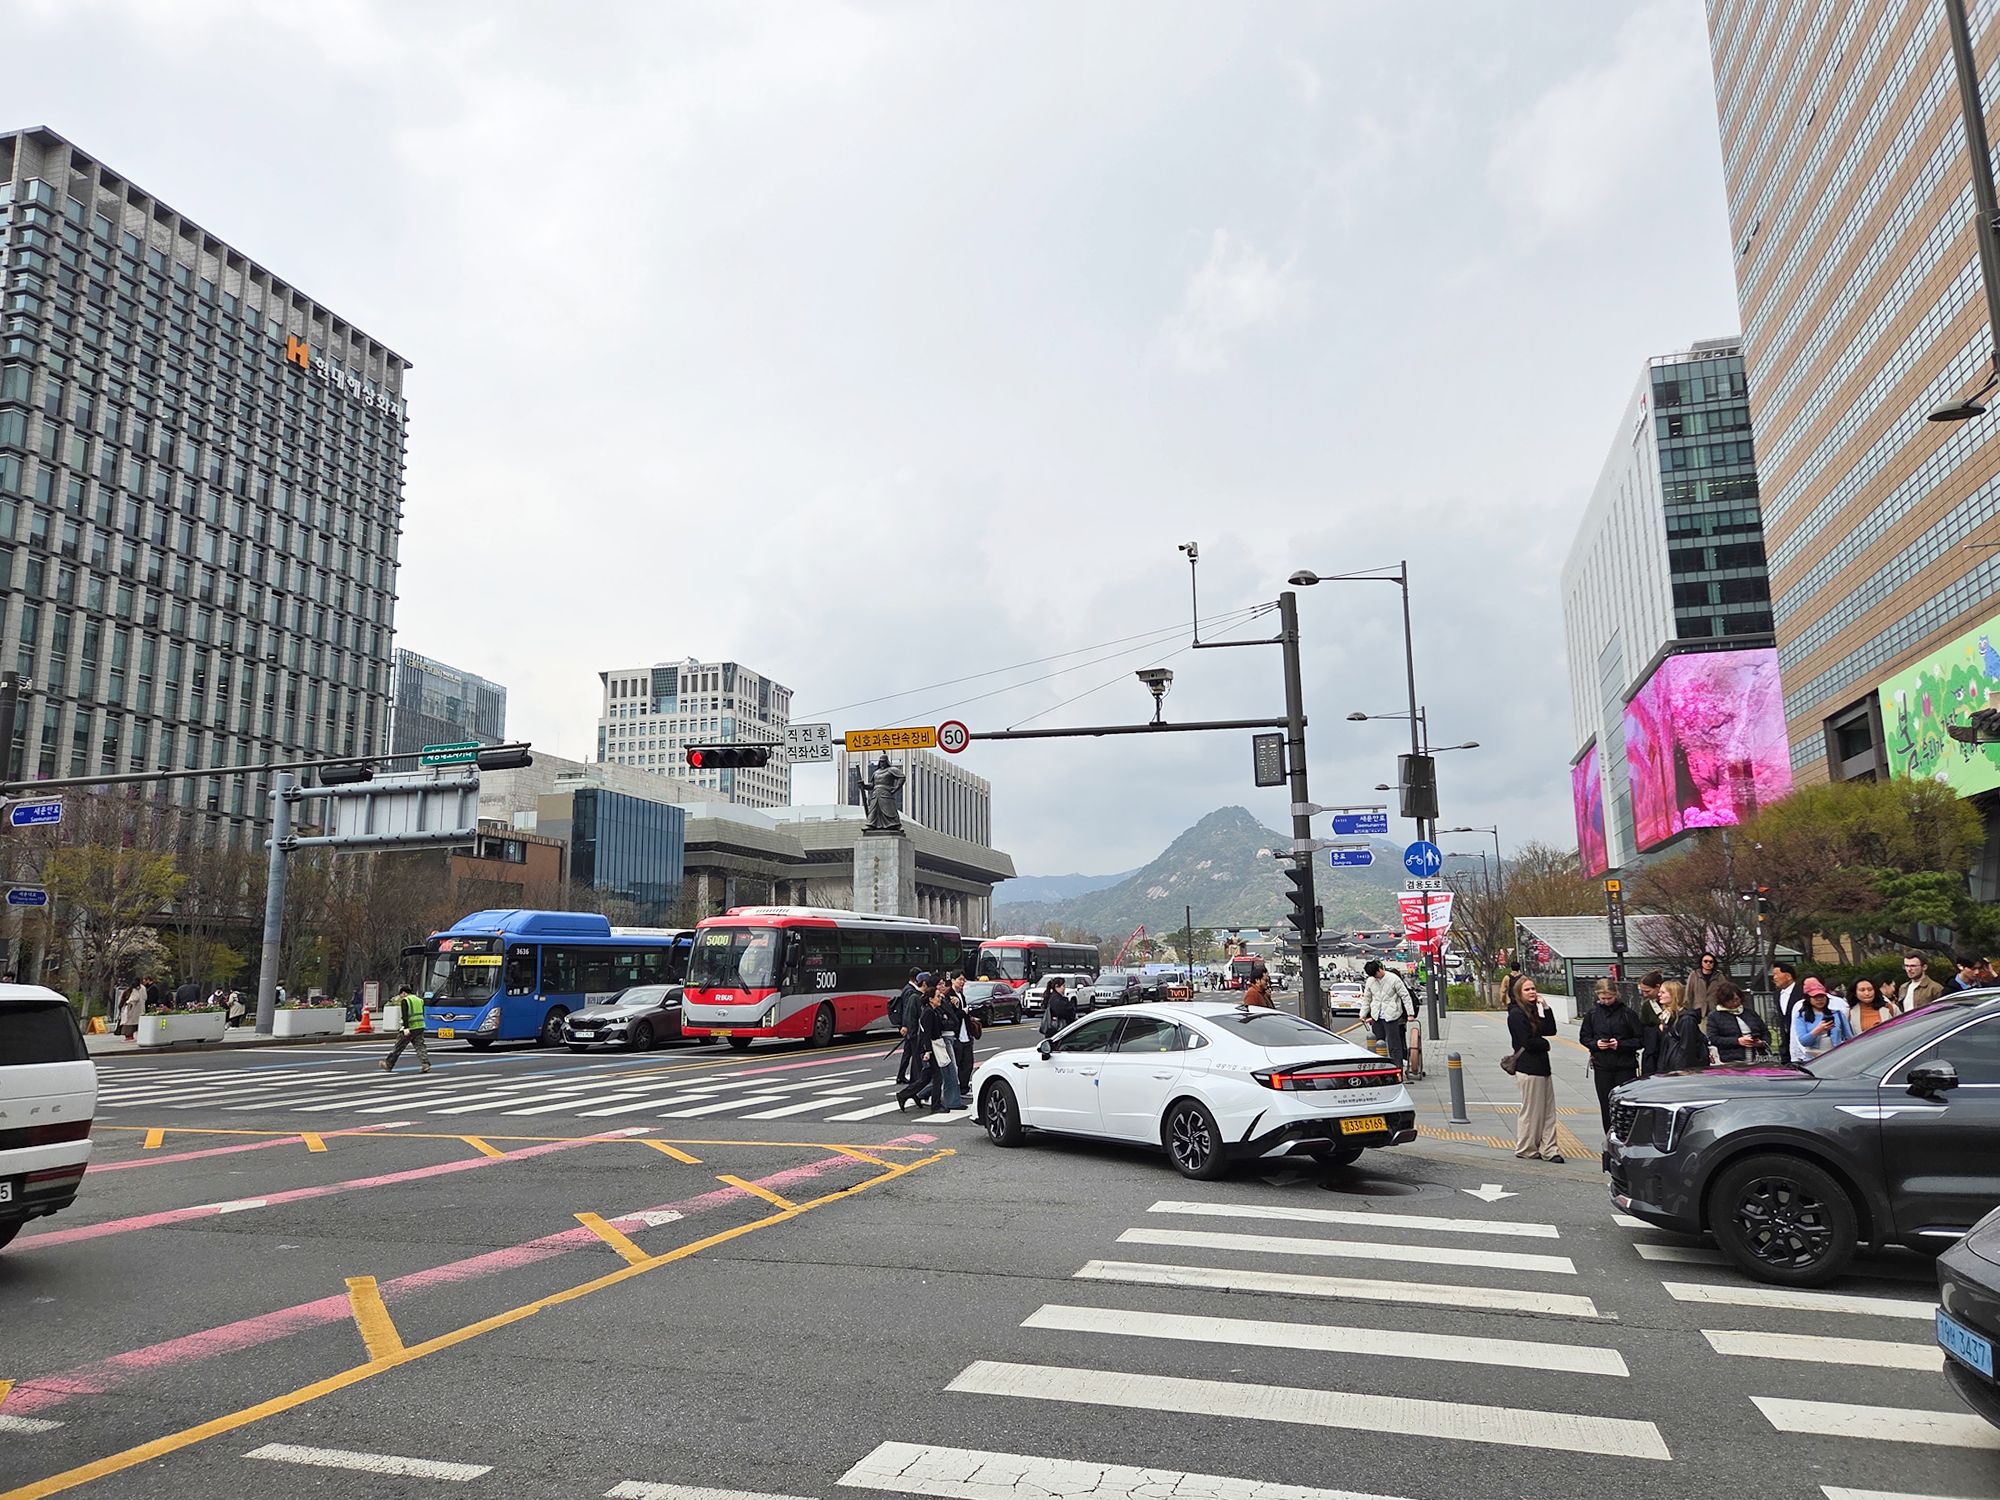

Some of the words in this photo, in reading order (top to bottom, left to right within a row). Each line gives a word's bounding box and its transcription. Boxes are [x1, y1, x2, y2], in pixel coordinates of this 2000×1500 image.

[314, 356, 403, 424] 현대해상화재
[852, 731, 930, 748] 신호과속단속장비
[944, 729, 963, 745] 50
[787, 744, 831, 760] 직좌신호
[706, 935, 728, 946] 5000
[816, 971, 837, 989] 5000
[1365, 1118, 1383, 1130] 6169
[1958, 1330, 1986, 1368] 3437
